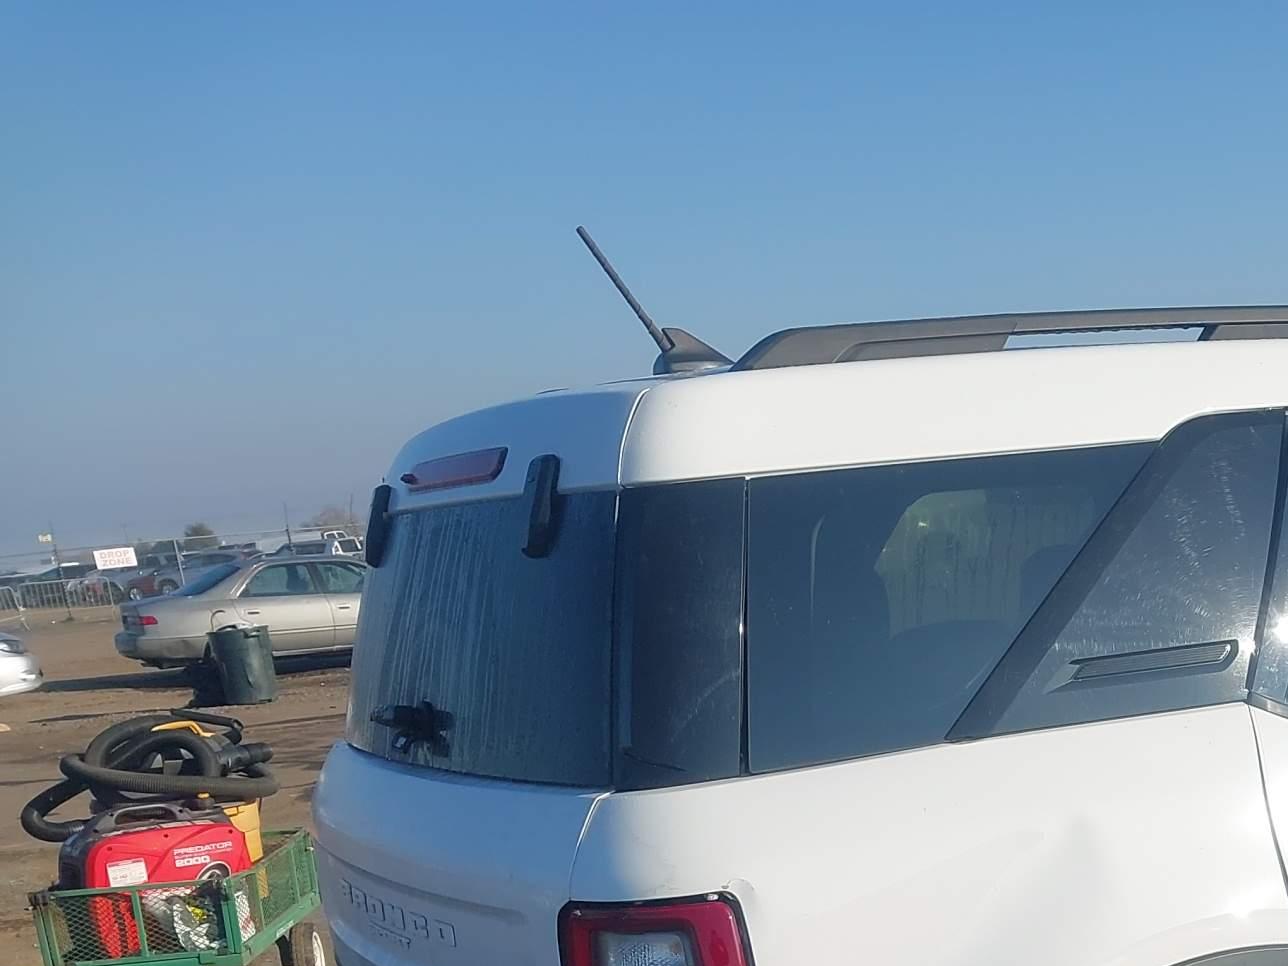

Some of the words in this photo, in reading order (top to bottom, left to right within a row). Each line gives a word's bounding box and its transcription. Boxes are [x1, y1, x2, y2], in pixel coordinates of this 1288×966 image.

[99, 549, 129, 559] DROP
[102, 558, 131, 567] ZONE
[173, 841, 232, 856] PREDATOR
[175, 855, 210, 868] 2000
